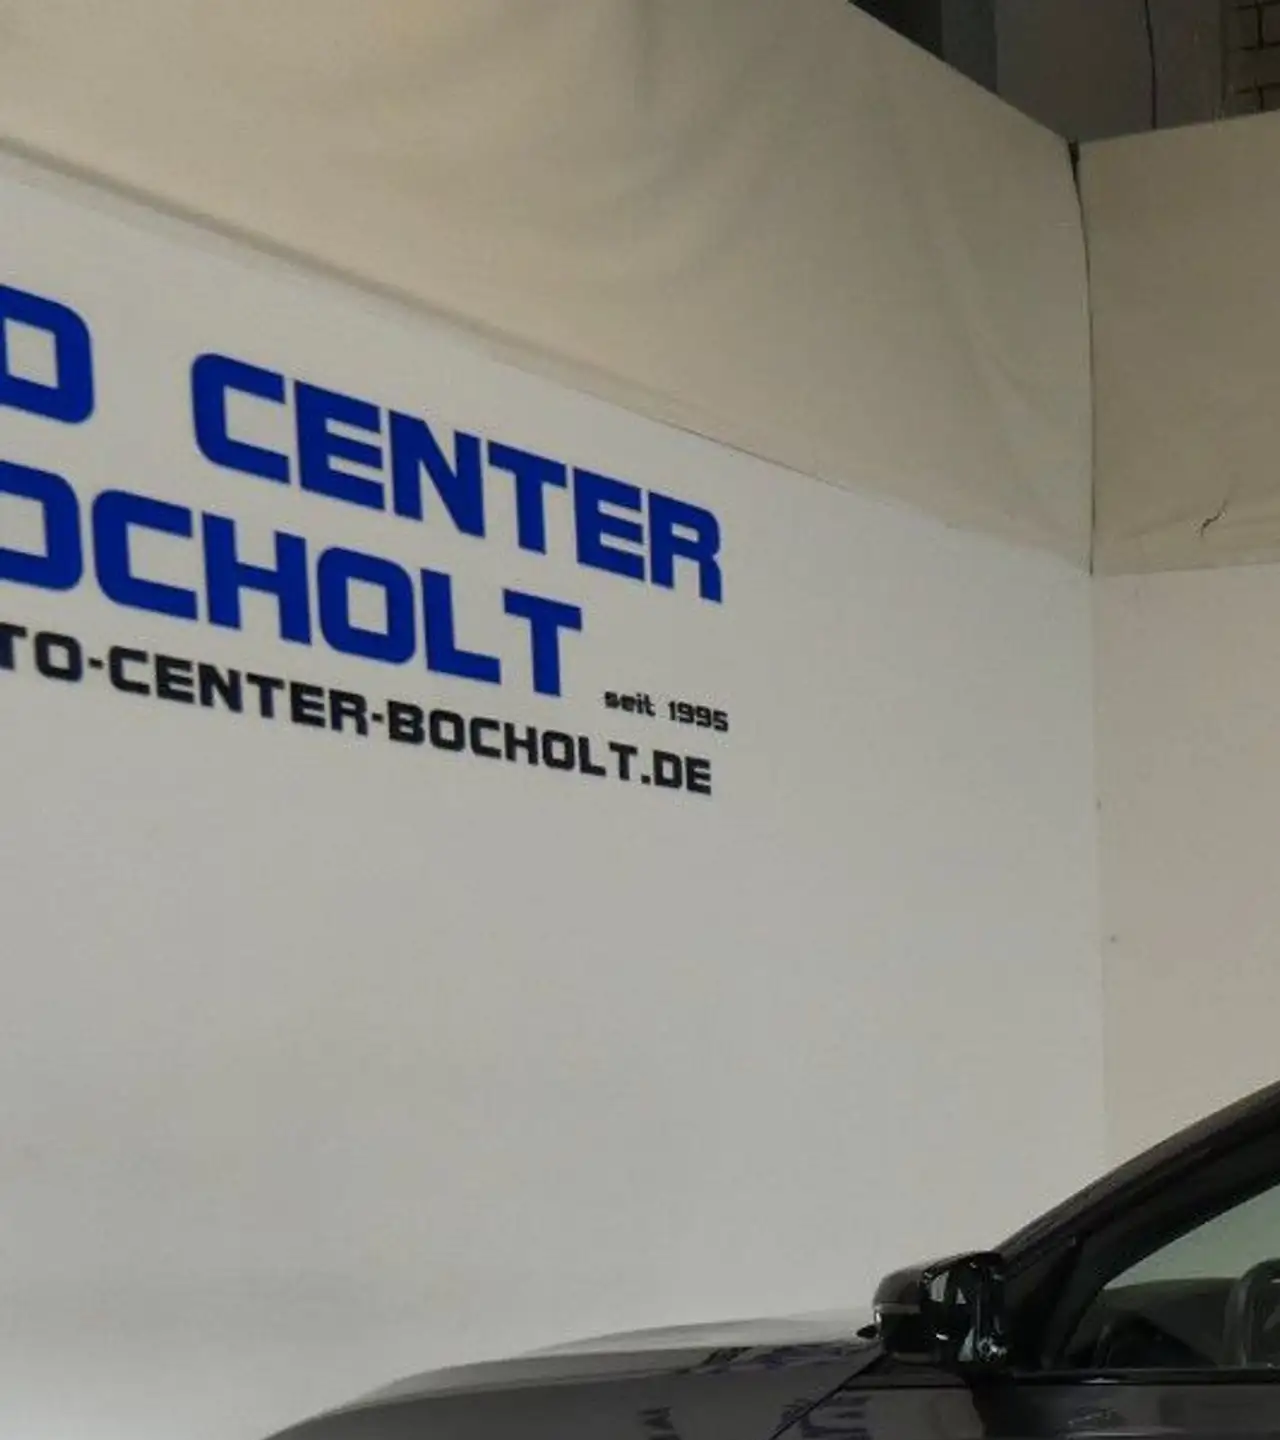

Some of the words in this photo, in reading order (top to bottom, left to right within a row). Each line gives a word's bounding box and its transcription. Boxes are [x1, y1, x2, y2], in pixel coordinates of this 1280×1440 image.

[0, 460, 583, 696] OCHOLT
[191, 353, 723, 602] CENTER
[0, 620, 712, 796] TO-CENTER-BOCHOLT.DE
[603, 690, 656, 717] seit
[667, 700, 729, 733] 1995
